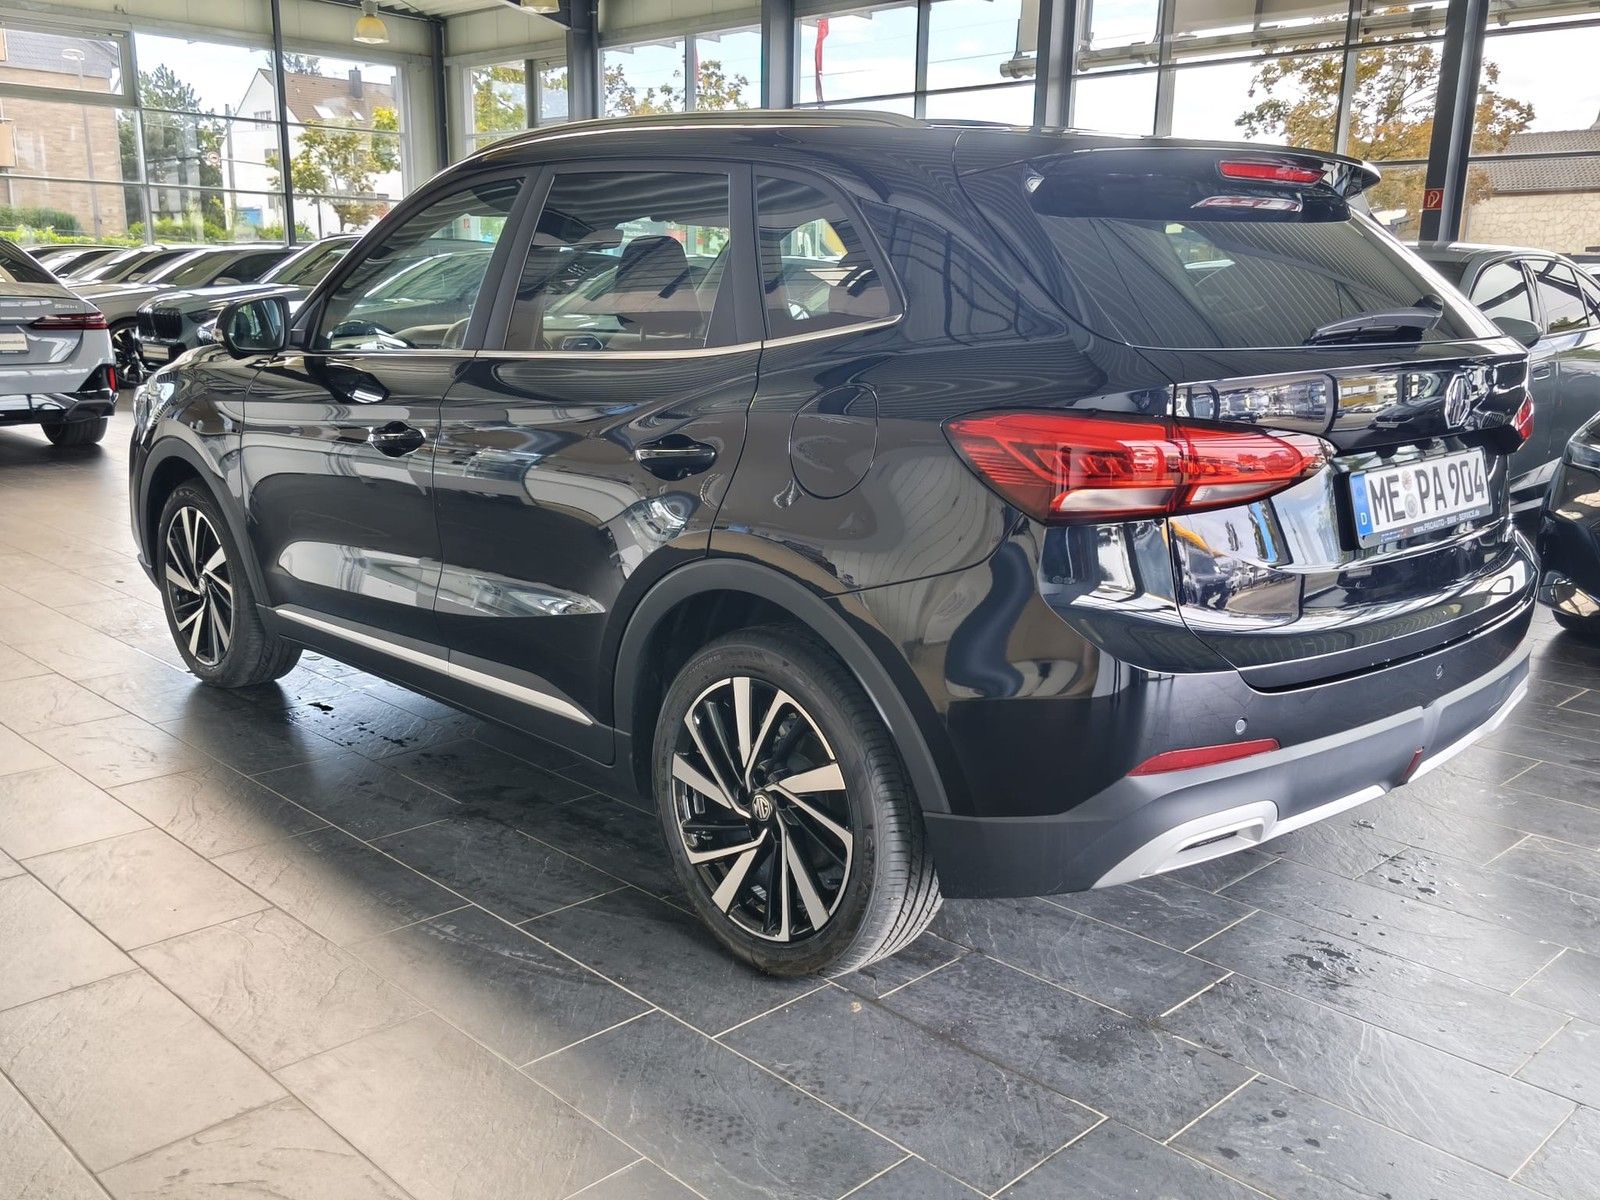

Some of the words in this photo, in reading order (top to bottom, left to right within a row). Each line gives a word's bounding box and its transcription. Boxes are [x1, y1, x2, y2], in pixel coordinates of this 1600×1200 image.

[1369, 474, 1406, 526] ME
[1414, 466, 1448, 514] PA
[1448, 458, 1485, 506] 904
[1360, 512, 1367, 526] D
